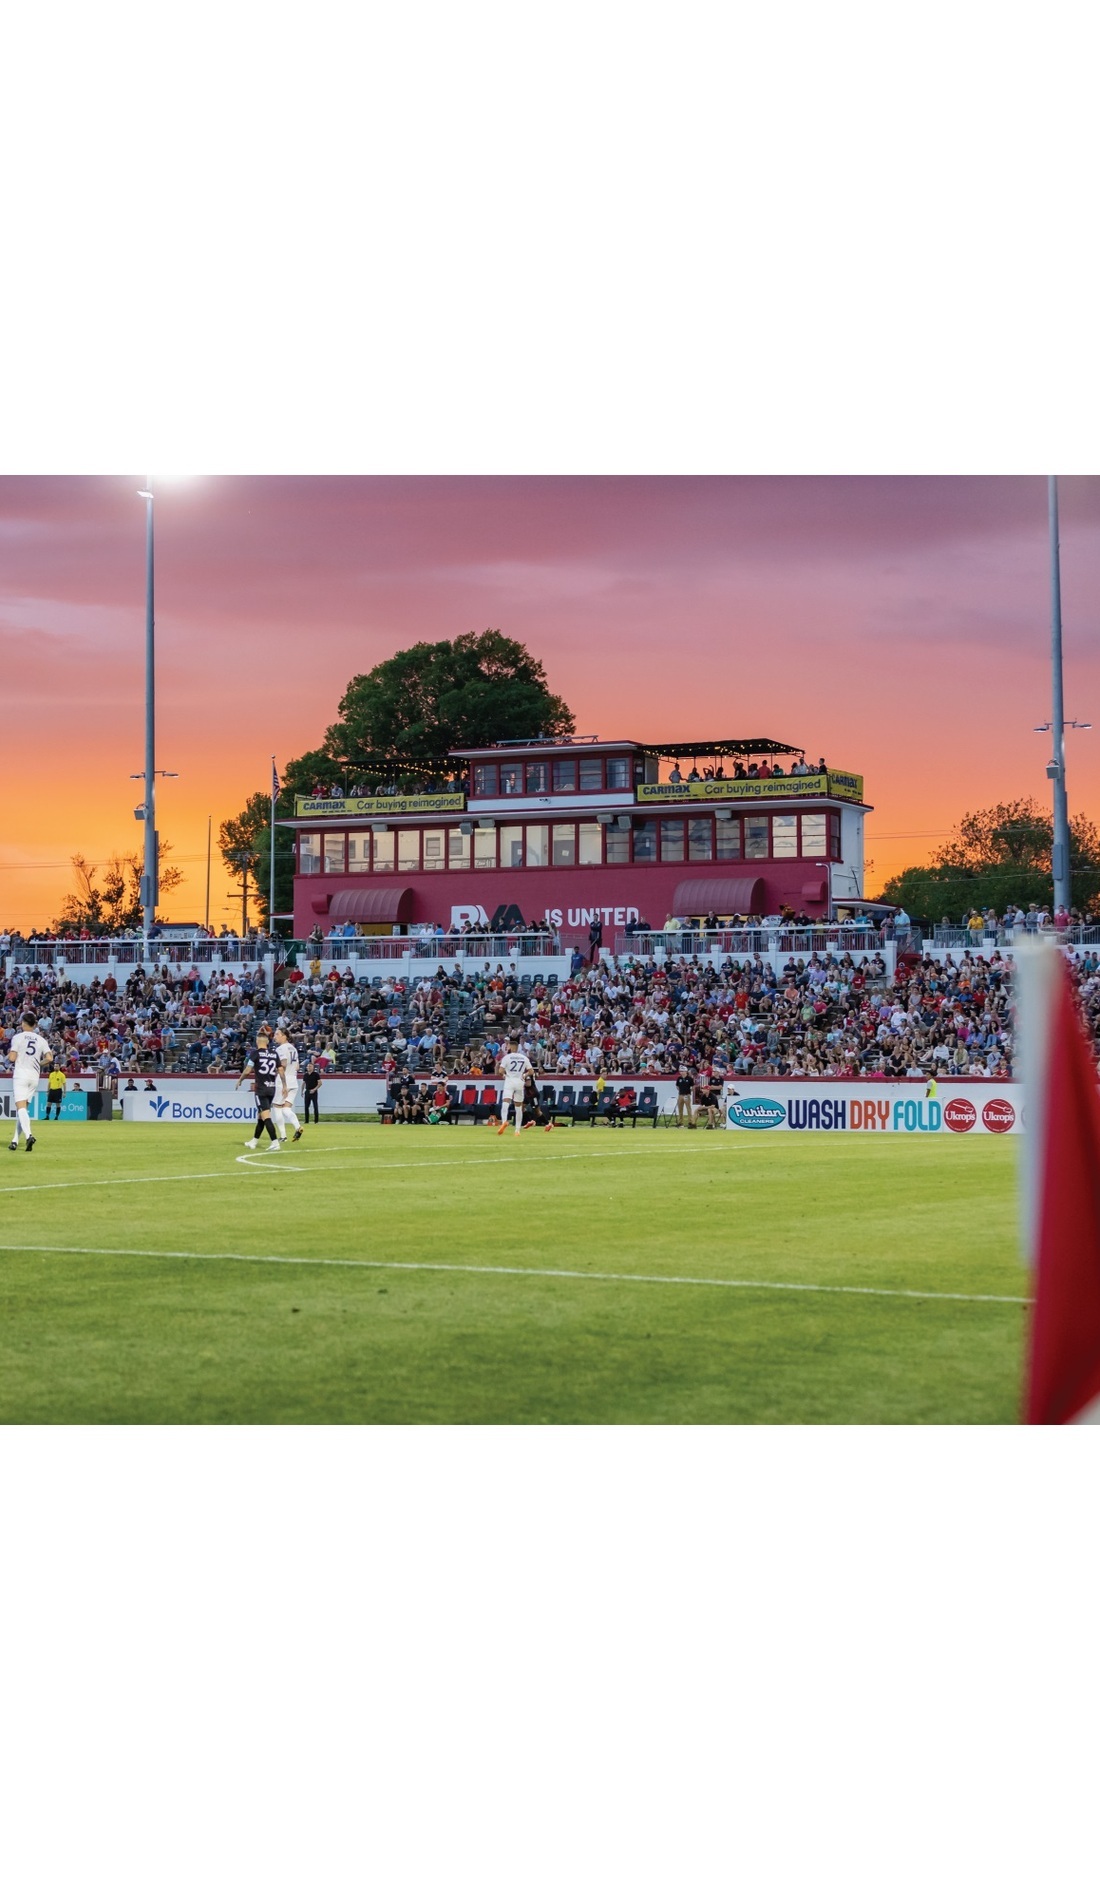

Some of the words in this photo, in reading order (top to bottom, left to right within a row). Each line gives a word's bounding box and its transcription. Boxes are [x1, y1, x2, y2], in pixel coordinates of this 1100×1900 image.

[705, 784, 724, 794] Car
[726, 784, 760, 795] buying
[763, 779, 821, 793] reimagined
[357, 800, 374, 810] Car
[376, 799, 406, 810] buying
[408, 796, 461, 808] reimagined
[545, 909, 563, 927] IS
[567, 907, 639, 927] UNITED
[25, 1040, 36, 1056] 5
[258, 1058, 277, 1076] 32
[510, 1060, 525, 1072] 27
[67, 1103, 84, 1112] One
[172, 1102, 202, 1119] Bon
[205, 1103, 259, 1119] Secour
[732, 1104, 786, 1117] Puritan
[787, 1099, 846, 1130] WASH
[850, 1100, 890, 1130] DRY
[893, 1100, 942, 1131] FOLD
